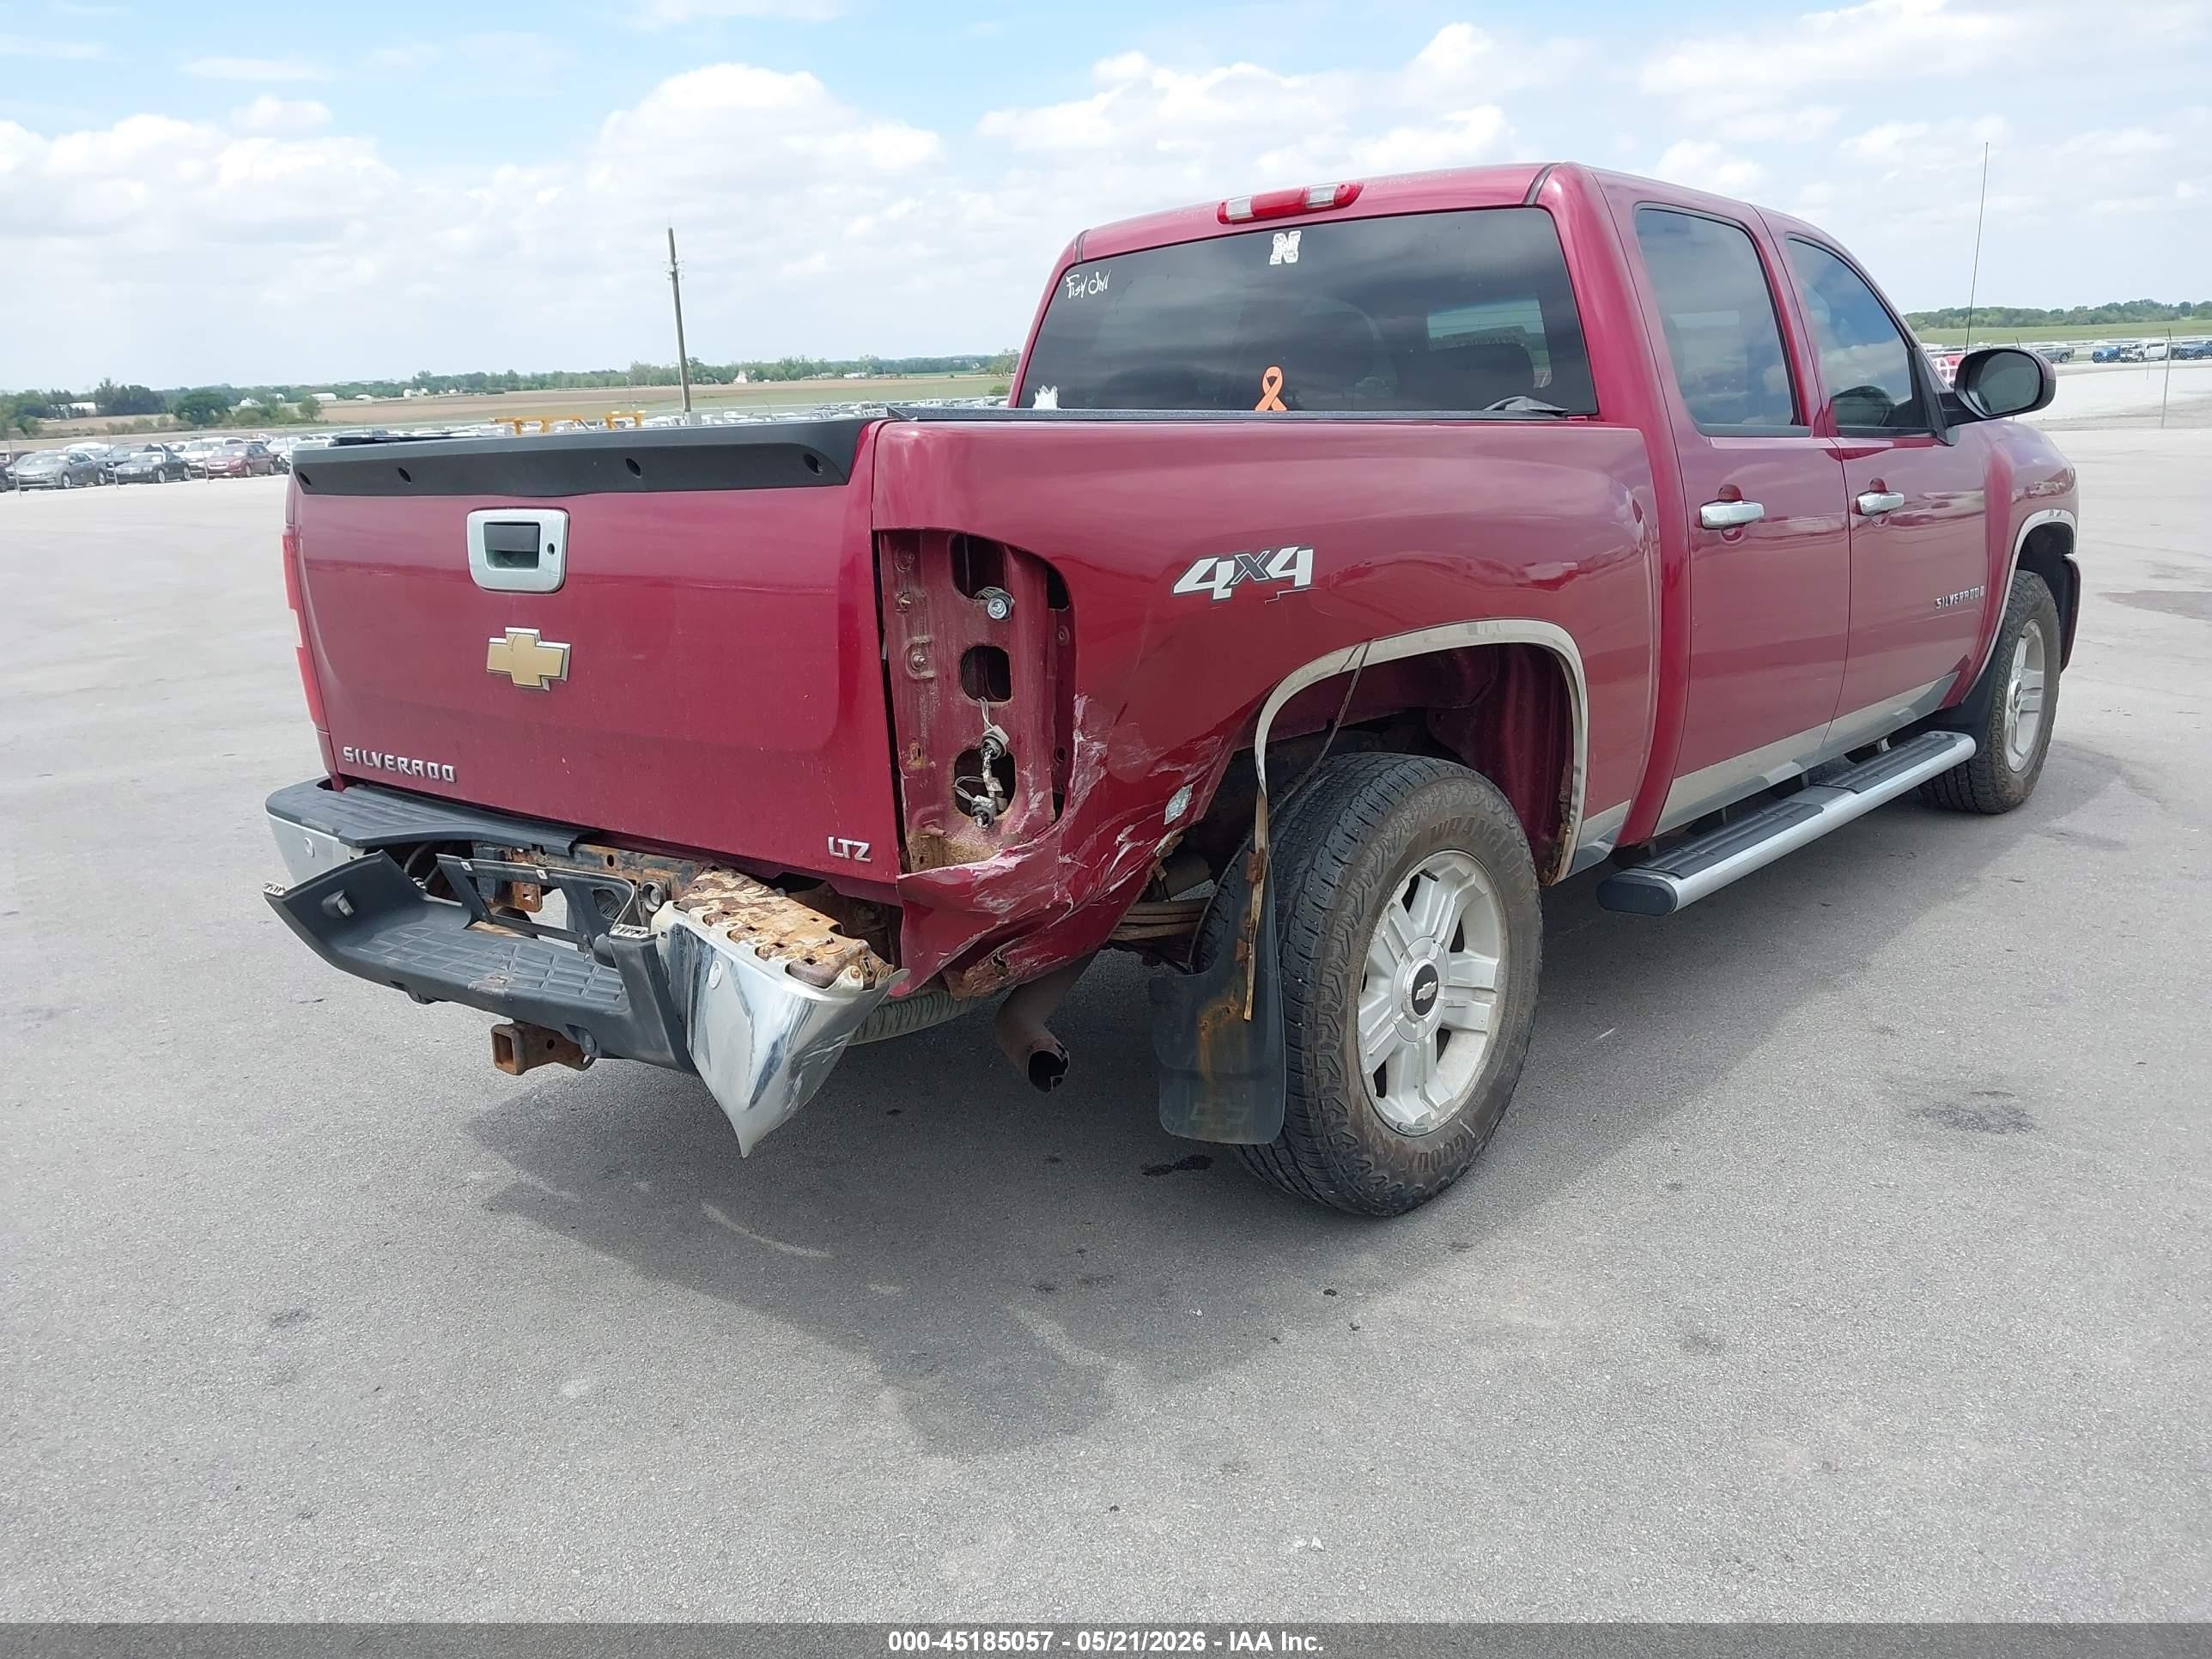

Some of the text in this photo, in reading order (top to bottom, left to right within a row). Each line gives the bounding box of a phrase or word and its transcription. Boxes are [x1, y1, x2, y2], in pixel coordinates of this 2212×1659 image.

[1269, 230, 1302, 265] N
[1936, 586, 1980, 609] SILVERADO
[343, 746, 457, 783] SILVERADO
[828, 836, 872, 863] LTZ
